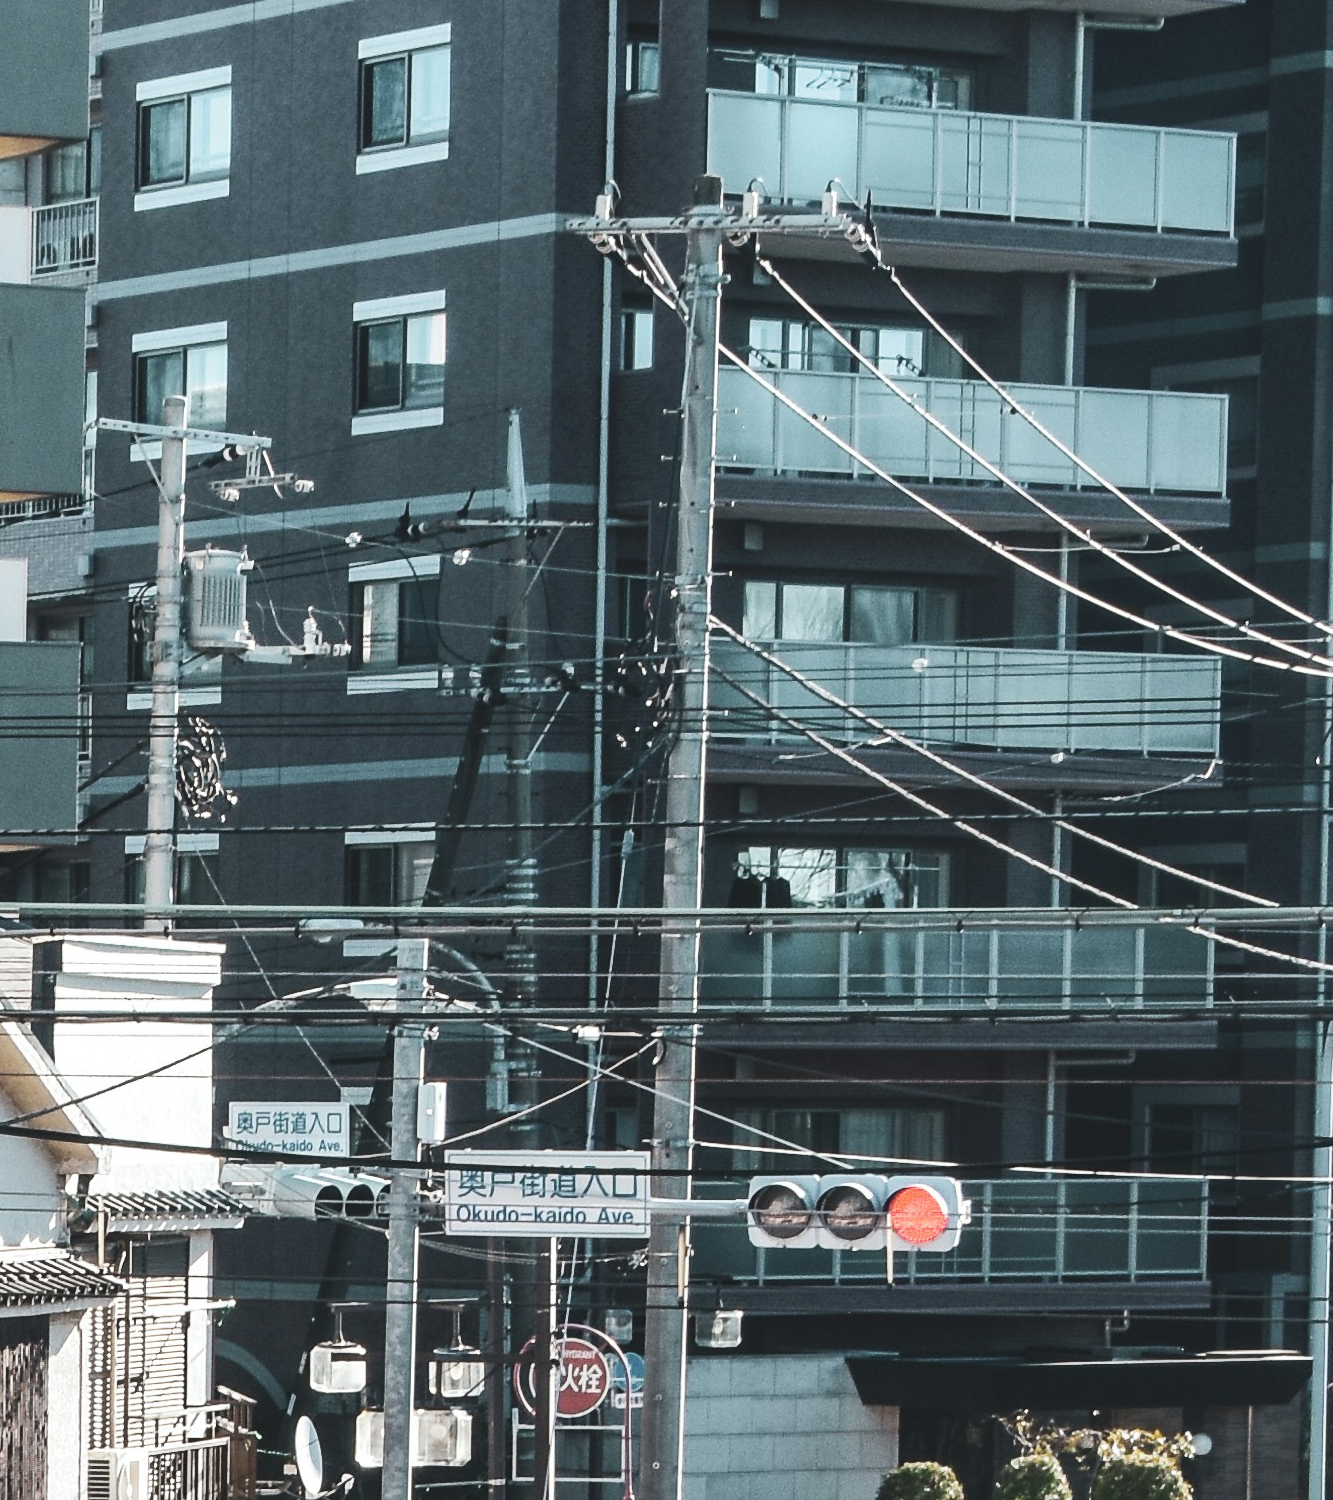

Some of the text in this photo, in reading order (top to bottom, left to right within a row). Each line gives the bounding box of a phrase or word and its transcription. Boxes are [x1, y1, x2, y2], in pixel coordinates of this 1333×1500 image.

[236, 1111, 342, 1135] 奥戸街道入口
[318, 1140, 344, 1153] Ave.
[458, 1165, 637, 1198] 奥戸街道入口
[456, 1204, 587, 1223] Okudo-kaido
[559, 1363, 604, 1393] 火栓
